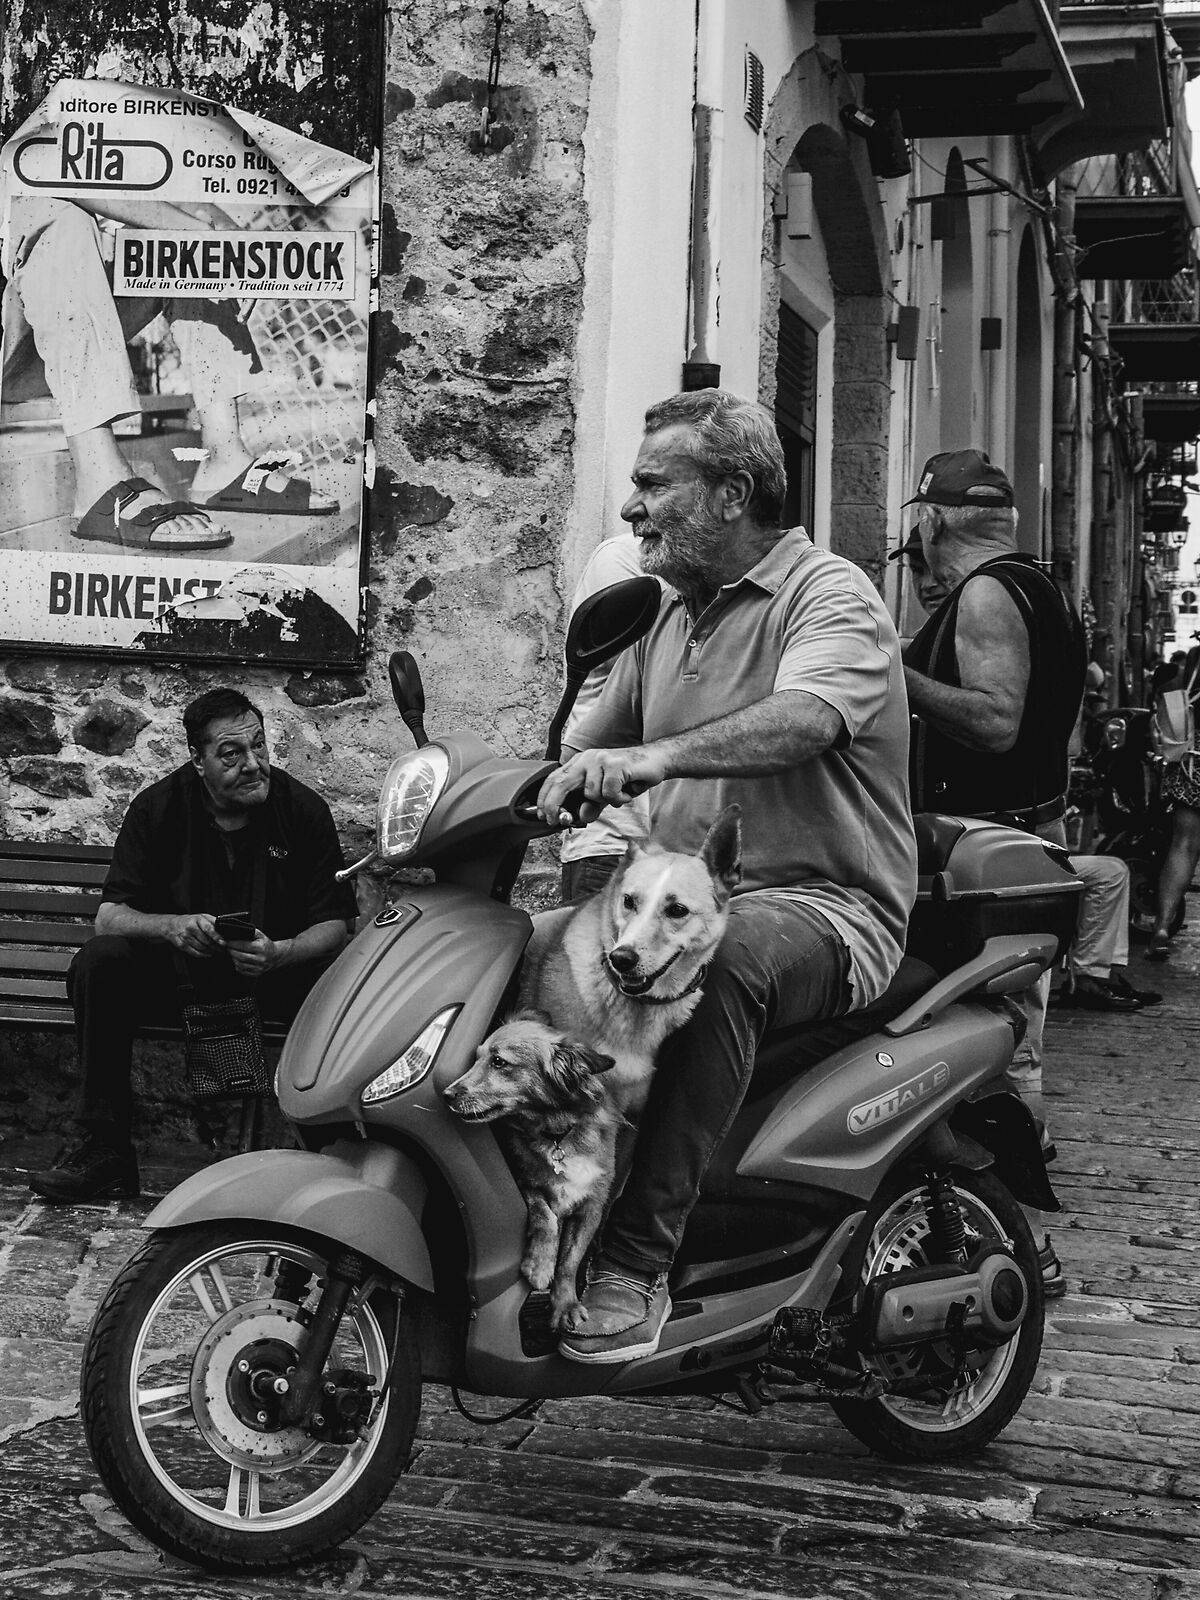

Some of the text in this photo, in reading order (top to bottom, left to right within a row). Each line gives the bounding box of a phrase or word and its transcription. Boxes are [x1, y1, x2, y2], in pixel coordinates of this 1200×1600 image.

[60, 122, 124, 181] Rita
[182, 150, 236, 170] Corso
[203, 177, 231, 194] Tel.
[237, 178, 278, 195] 0921
[122, 239, 344, 281] BIRKENSTOCK
[124, 279, 344, 293] Made in Germany Tradition seit 1774
[853, 1067, 946, 1126] VITALE
